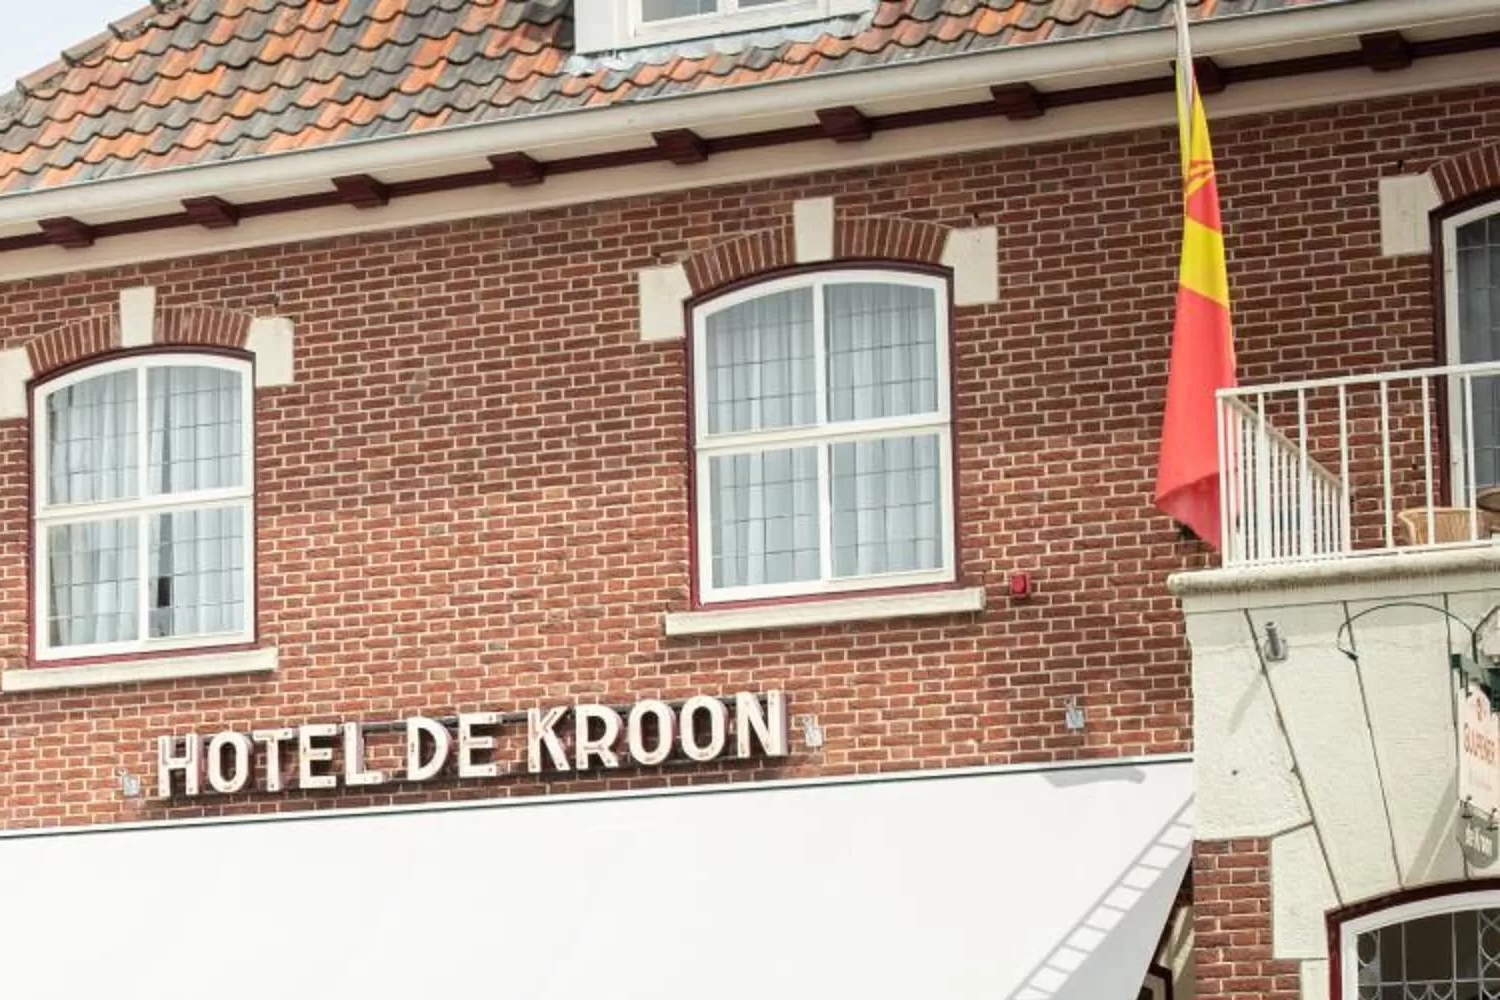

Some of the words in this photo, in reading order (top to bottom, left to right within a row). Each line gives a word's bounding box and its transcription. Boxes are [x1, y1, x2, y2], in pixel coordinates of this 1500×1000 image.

[157, 721, 386, 798] HOTEL
[405, 712, 499, 781] DE
[527, 690, 789, 773] KROON
